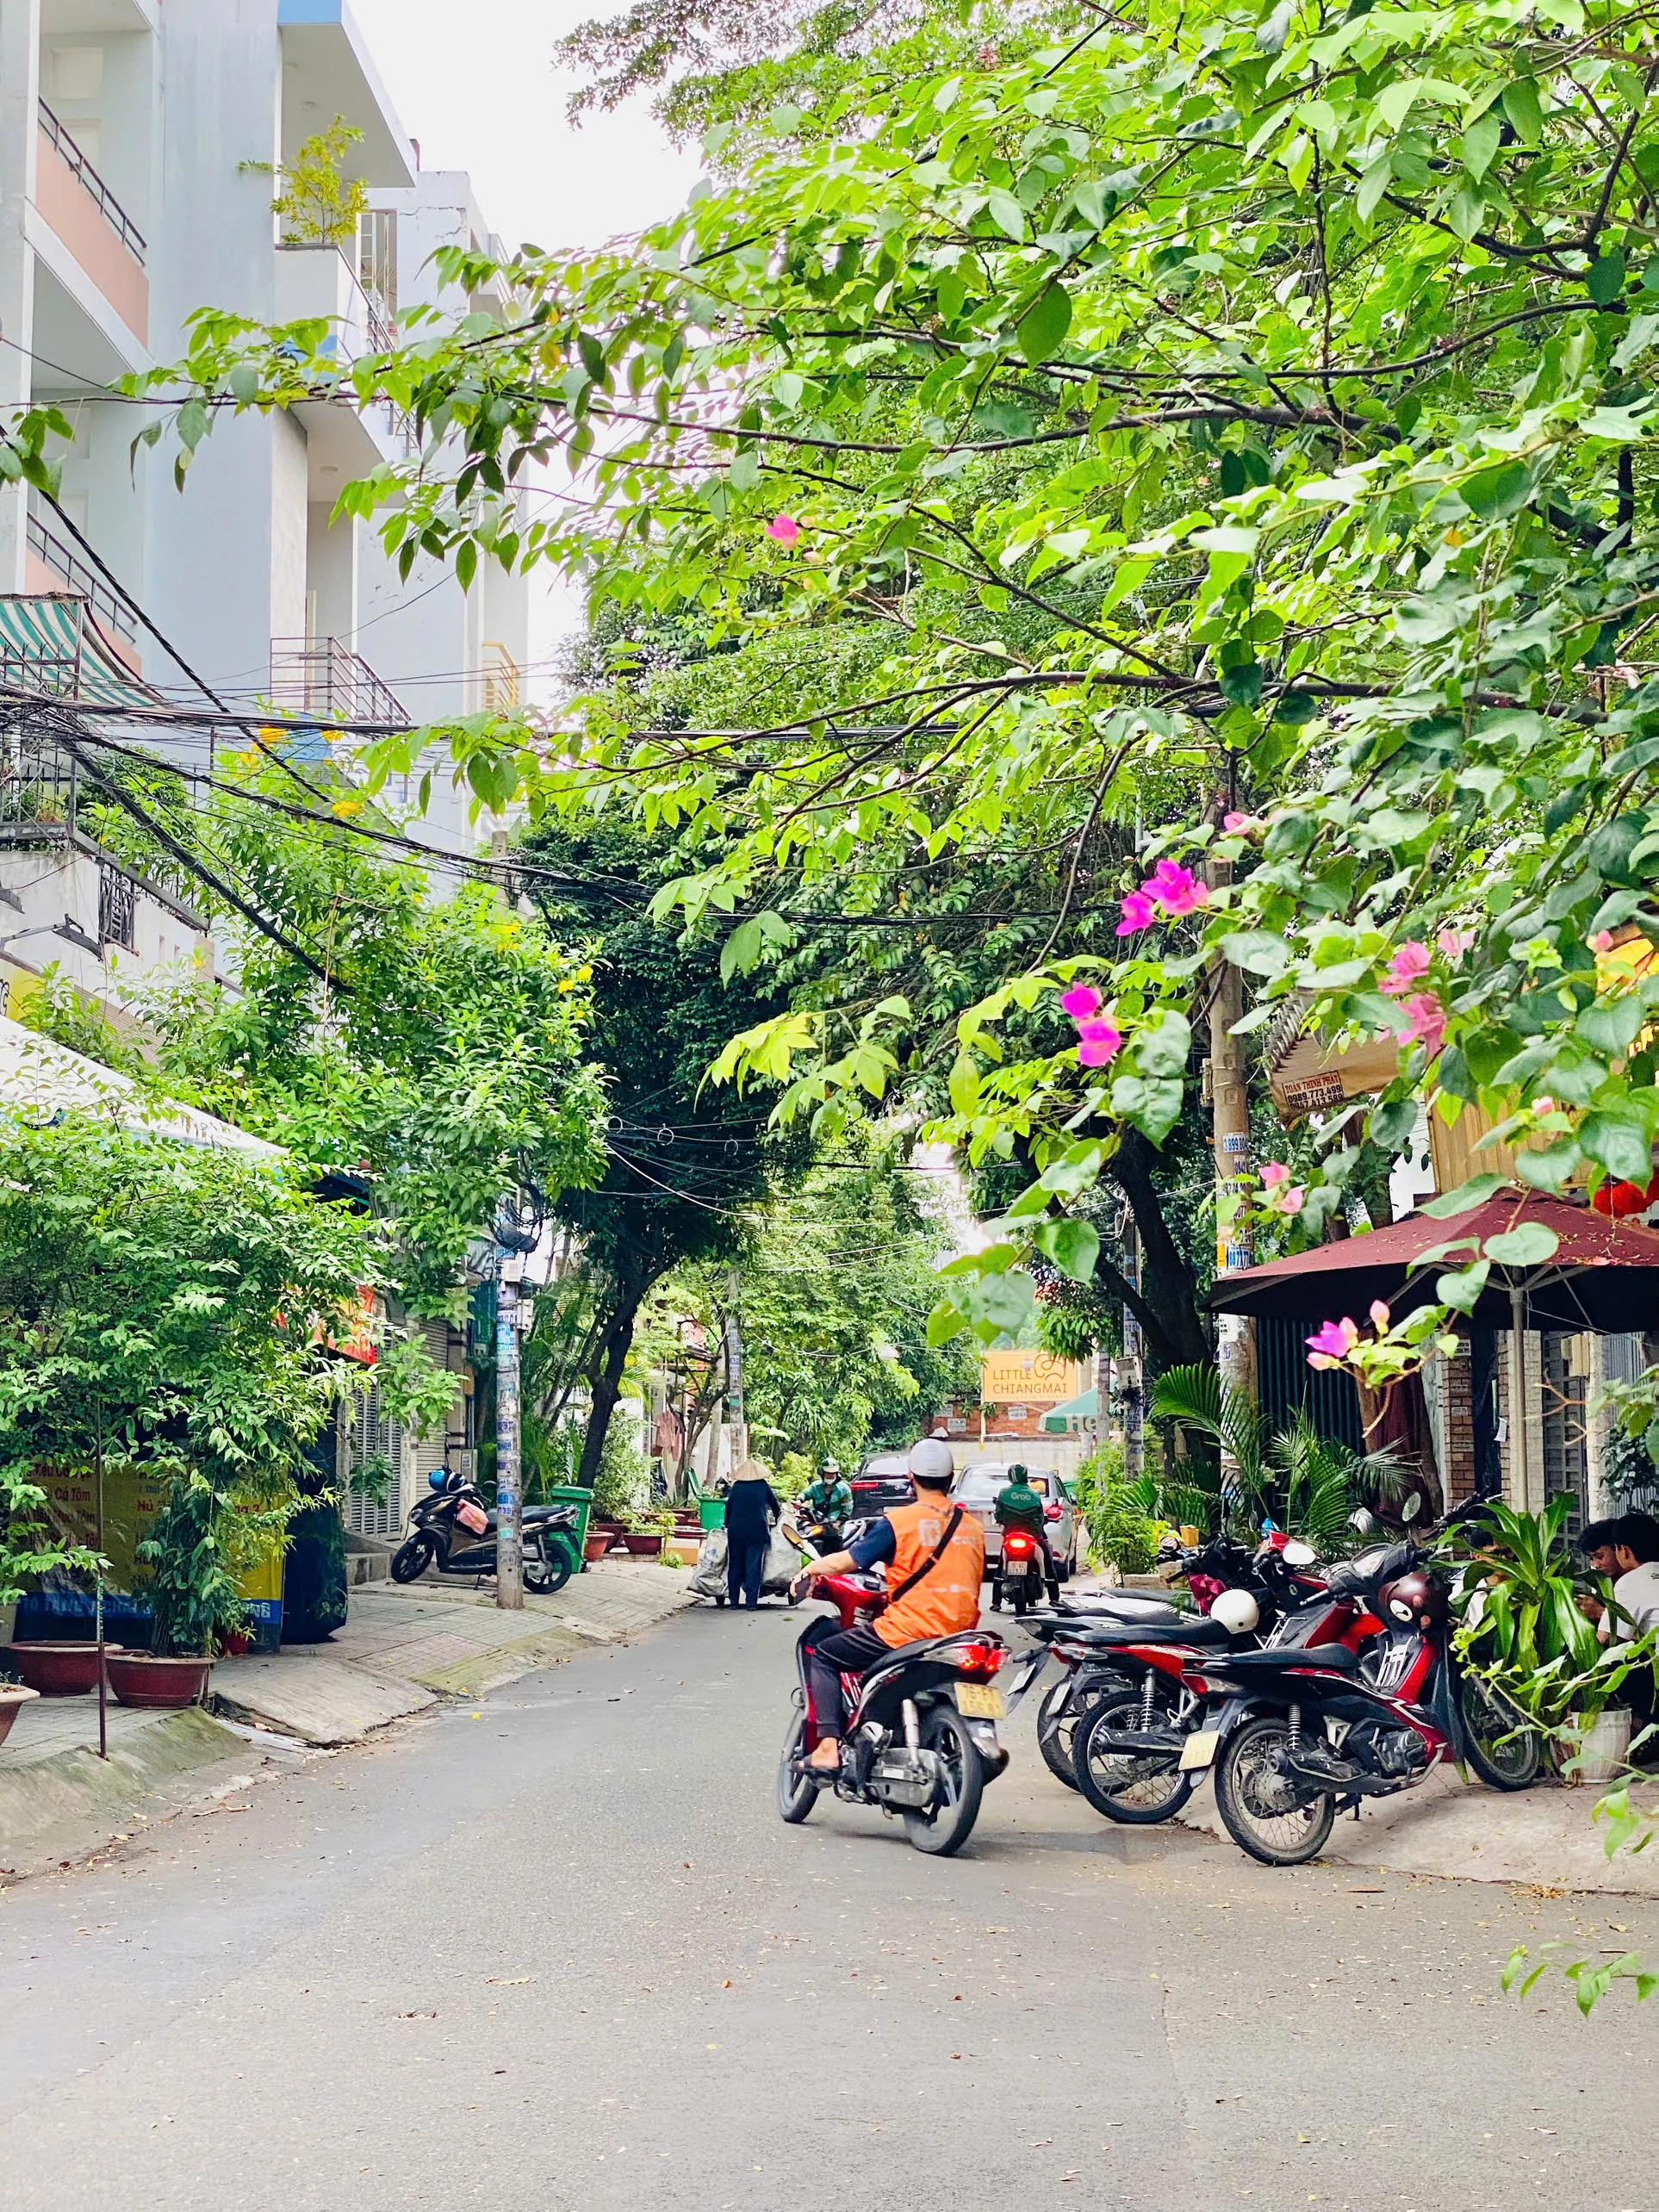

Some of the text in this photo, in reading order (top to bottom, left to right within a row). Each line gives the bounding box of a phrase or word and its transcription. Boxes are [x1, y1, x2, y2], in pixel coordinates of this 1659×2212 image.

[1287, 1084, 1342, 1103] 0989.773.499
[992, 1370, 1031, 1380] LITTLE
[992, 1383, 1068, 1395] CHIANGMAI
[1010, 1491, 1031, 1501] Grab
